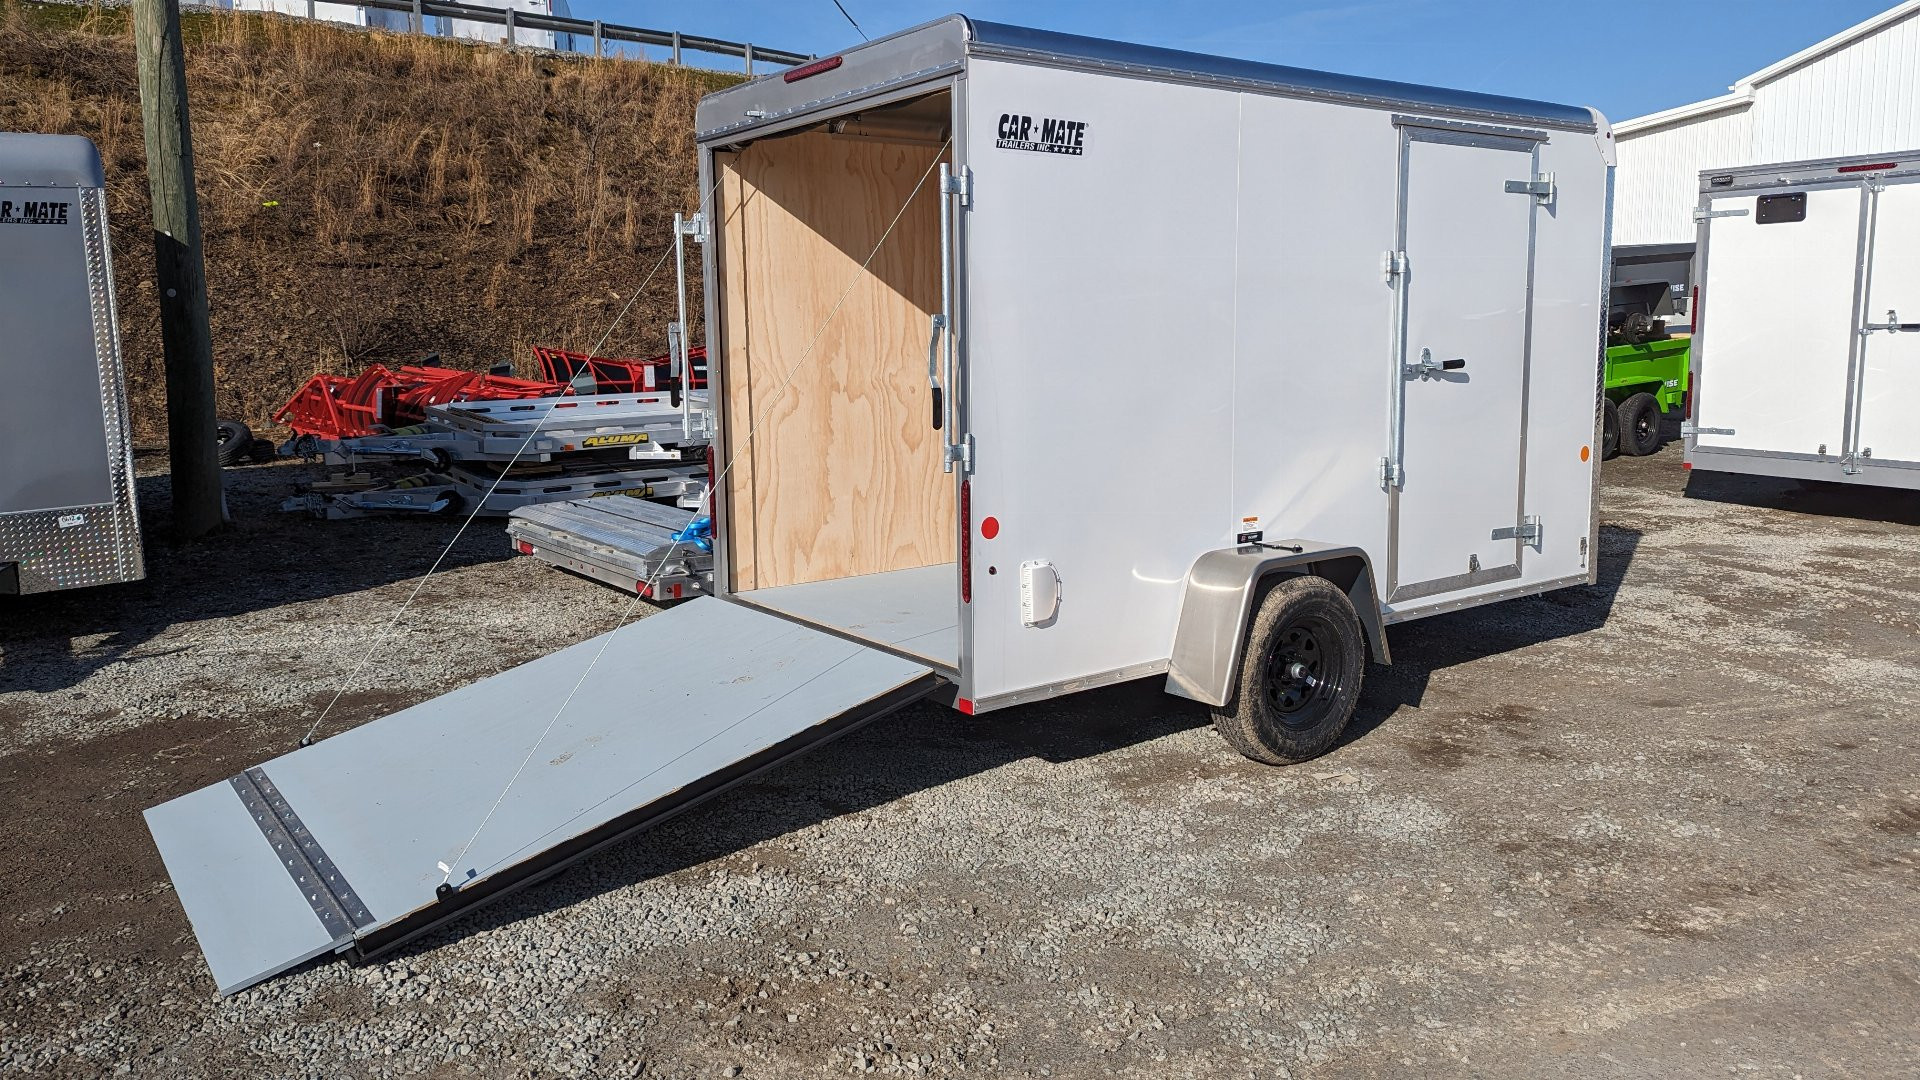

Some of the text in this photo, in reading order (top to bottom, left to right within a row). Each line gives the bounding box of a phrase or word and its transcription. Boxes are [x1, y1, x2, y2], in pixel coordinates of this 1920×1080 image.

[998, 113, 1085, 146] CAR MATE
[997, 139, 1052, 152] TRAILERS INC.
[24, 201, 68, 218] MATE
[583, 433, 648, 447] ALUMA
